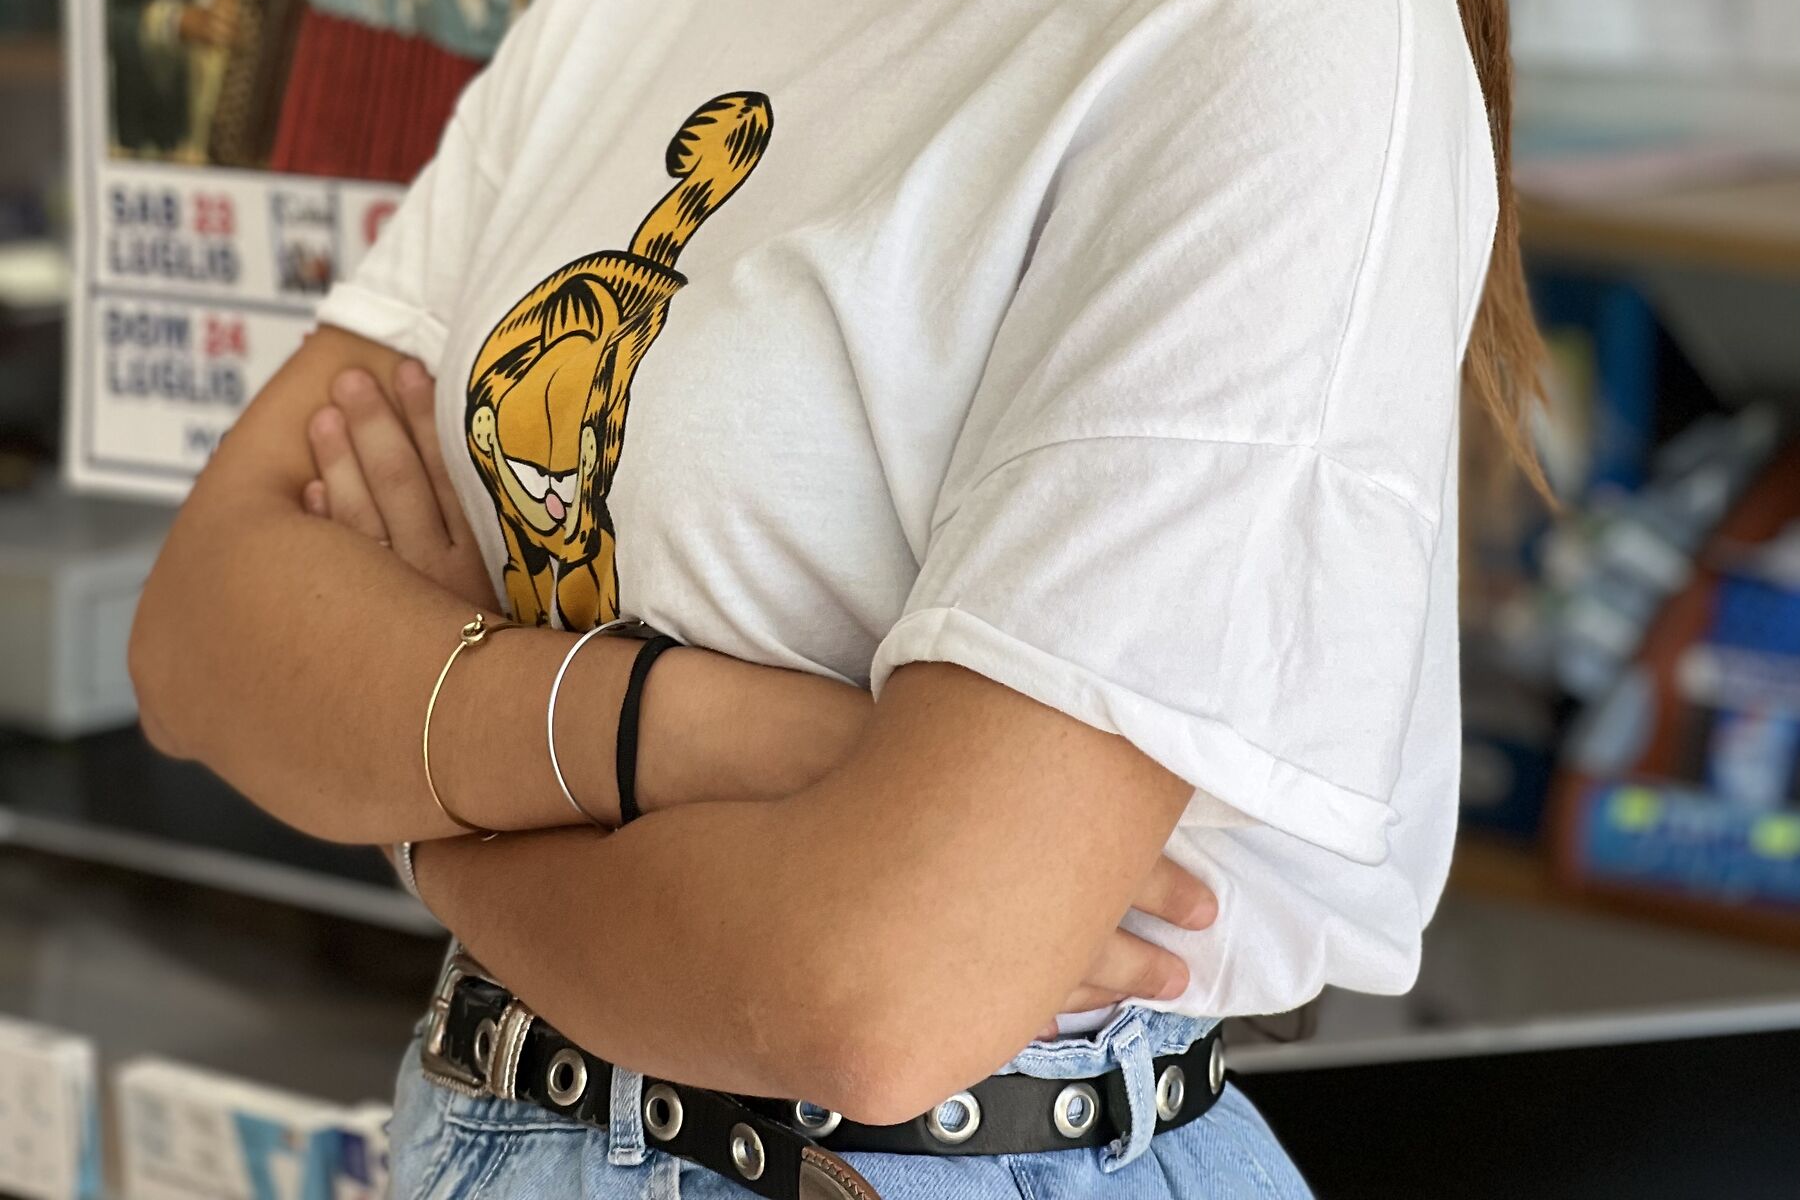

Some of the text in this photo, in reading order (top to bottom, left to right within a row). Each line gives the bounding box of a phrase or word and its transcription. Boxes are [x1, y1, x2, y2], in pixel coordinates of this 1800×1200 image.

[109, 187, 179, 227] SAB
[109, 238, 240, 284] LUGLIO
[107, 311, 247, 357] DOM 24
[109, 358, 244, 406] LUGLIO
